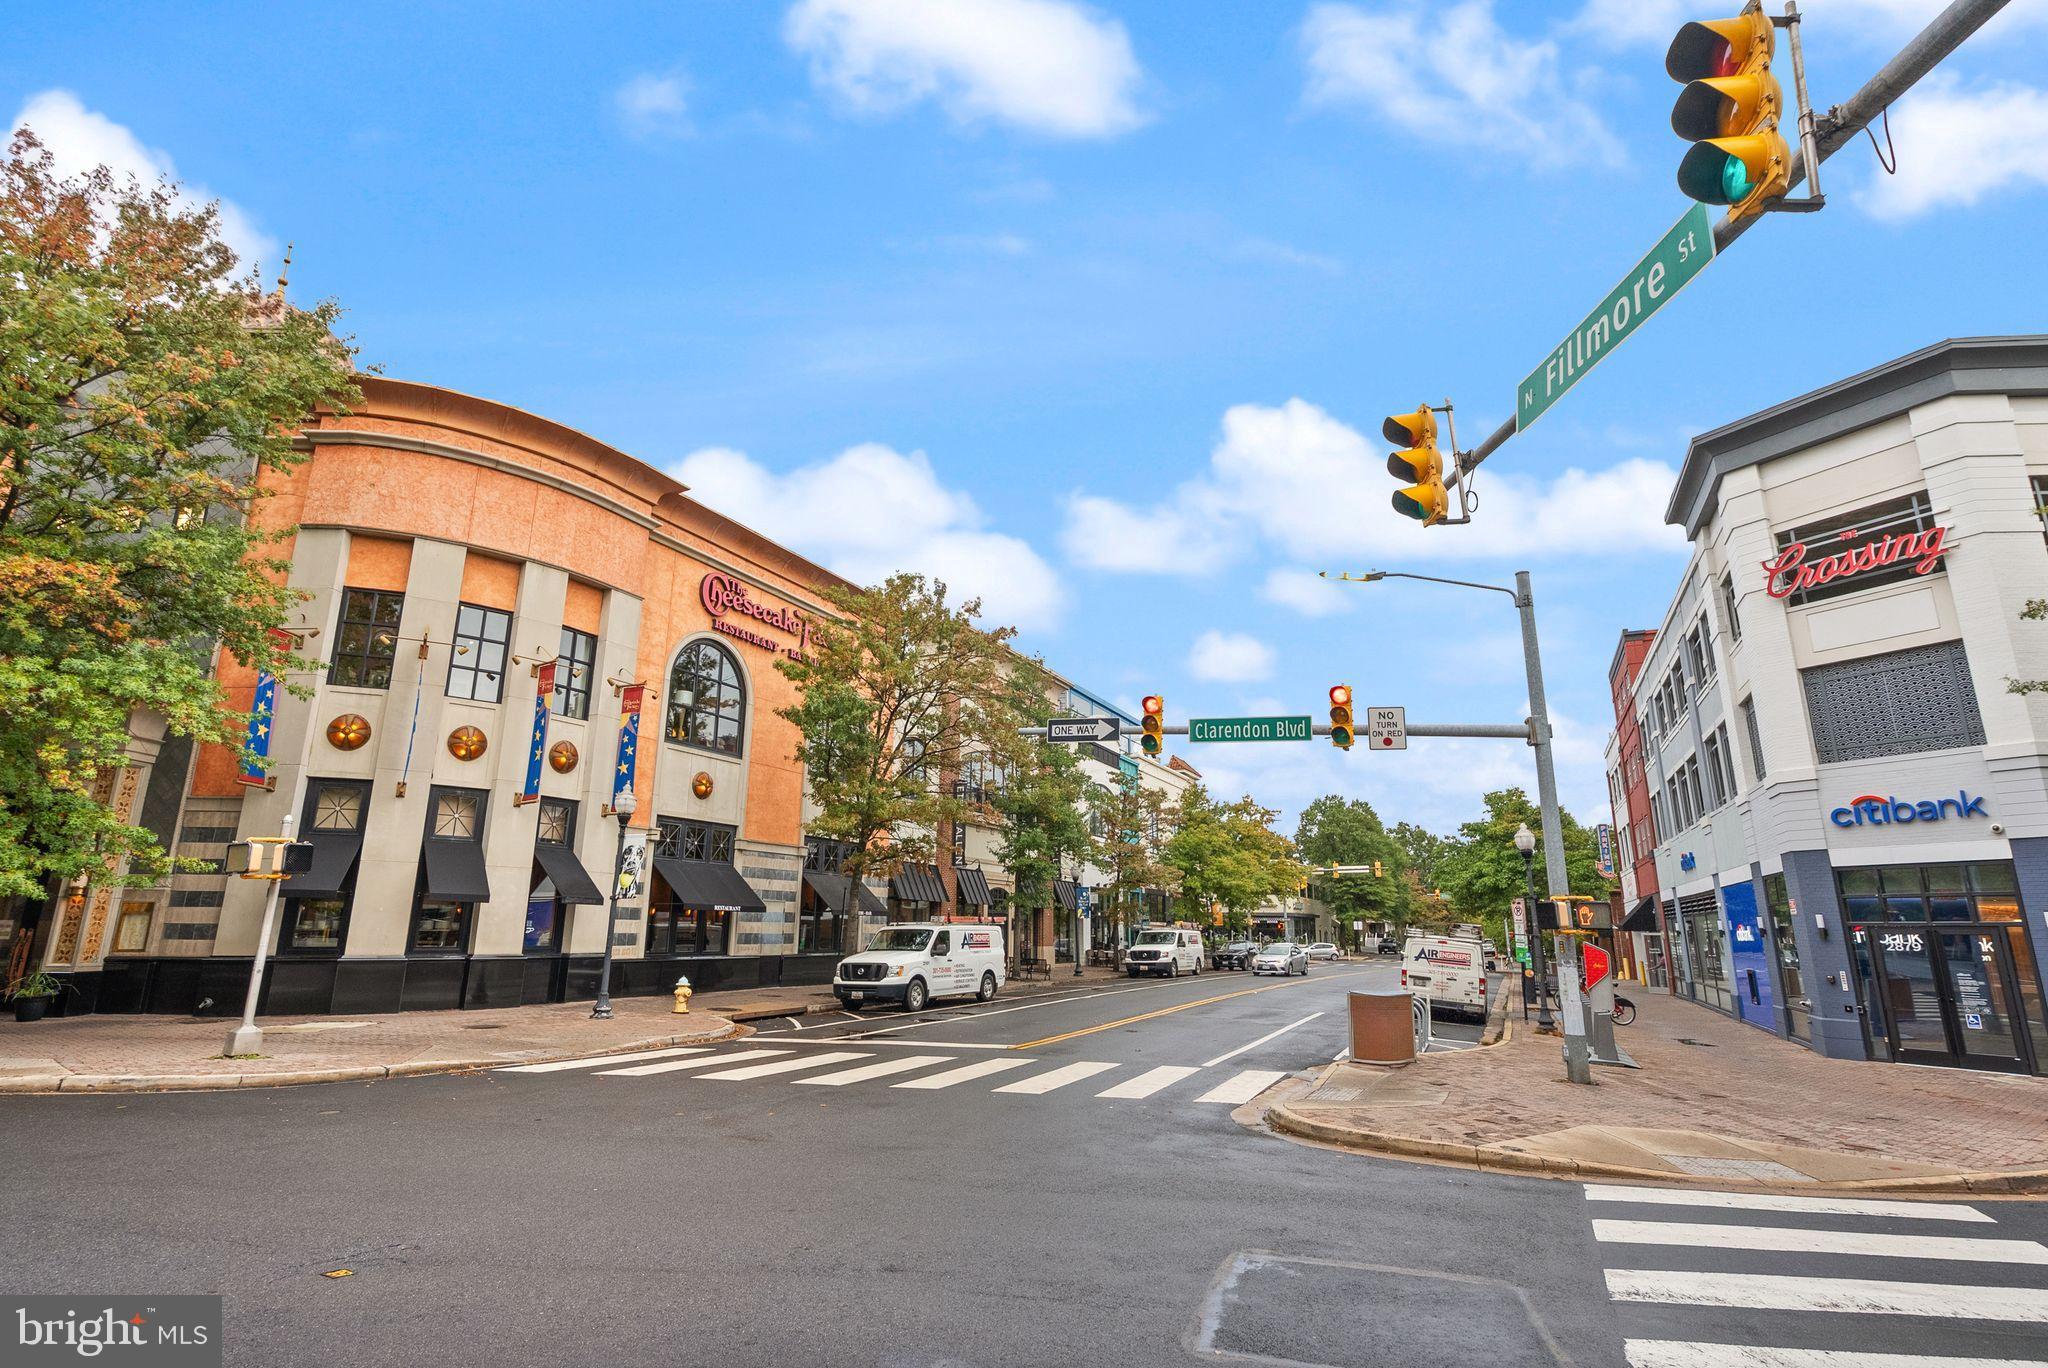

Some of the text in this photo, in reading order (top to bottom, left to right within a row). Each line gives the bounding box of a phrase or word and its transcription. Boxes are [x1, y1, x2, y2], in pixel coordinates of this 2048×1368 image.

[1525, 230, 1697, 409] N Fillmore St
[1839, 529, 1858, 541] THE
[1762, 527, 1951, 598] Crossing
[730, 578, 749, 597] The
[699, 571, 803, 637] Cheesecake
[712, 618, 779, 654] RESTAURANT
[1378, 711, 1395, 720] NO
[1054, 725, 1097, 736] ONE WAY
[1195, 721, 1306, 739] Clarendon Blvd
[1376, 721, 1398, 729] TURN
[1387, 729, 1403, 737] RED
[1831, 790, 1988, 828] citibank
[1414, 947, 1472, 961] AIR ENGINEERS
[1886, 942, 1922, 952] 2879
